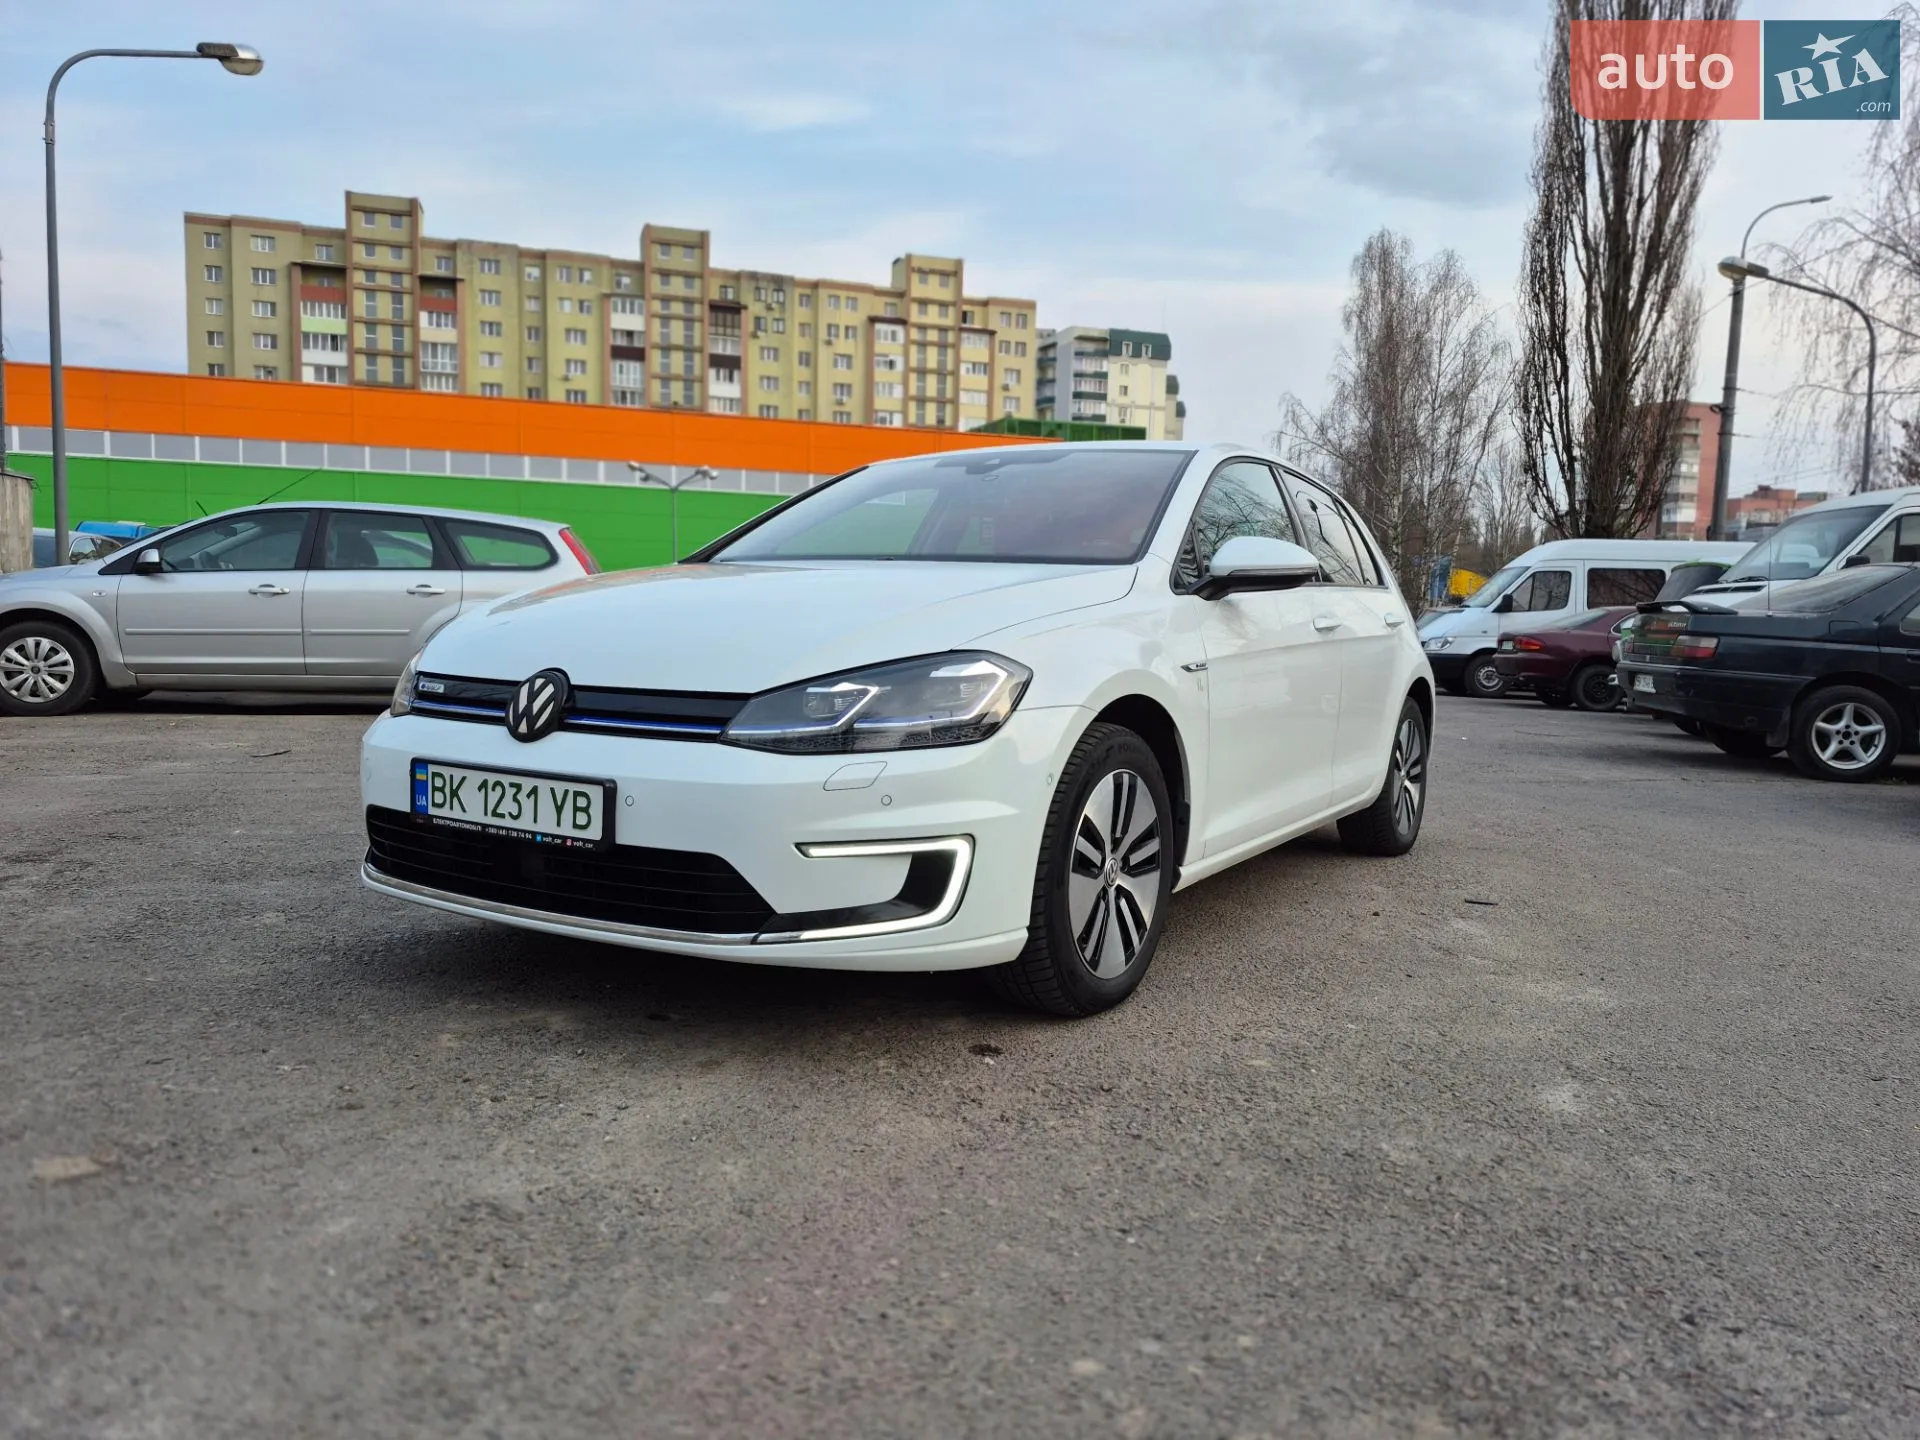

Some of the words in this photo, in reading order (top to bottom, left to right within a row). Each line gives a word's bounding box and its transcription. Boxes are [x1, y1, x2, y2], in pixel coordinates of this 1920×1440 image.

[415, 794, 428, 807] UA
[431, 771, 468, 814] BK
[477, 778, 540, 824] 1231
[550, 787, 592, 831] YB
